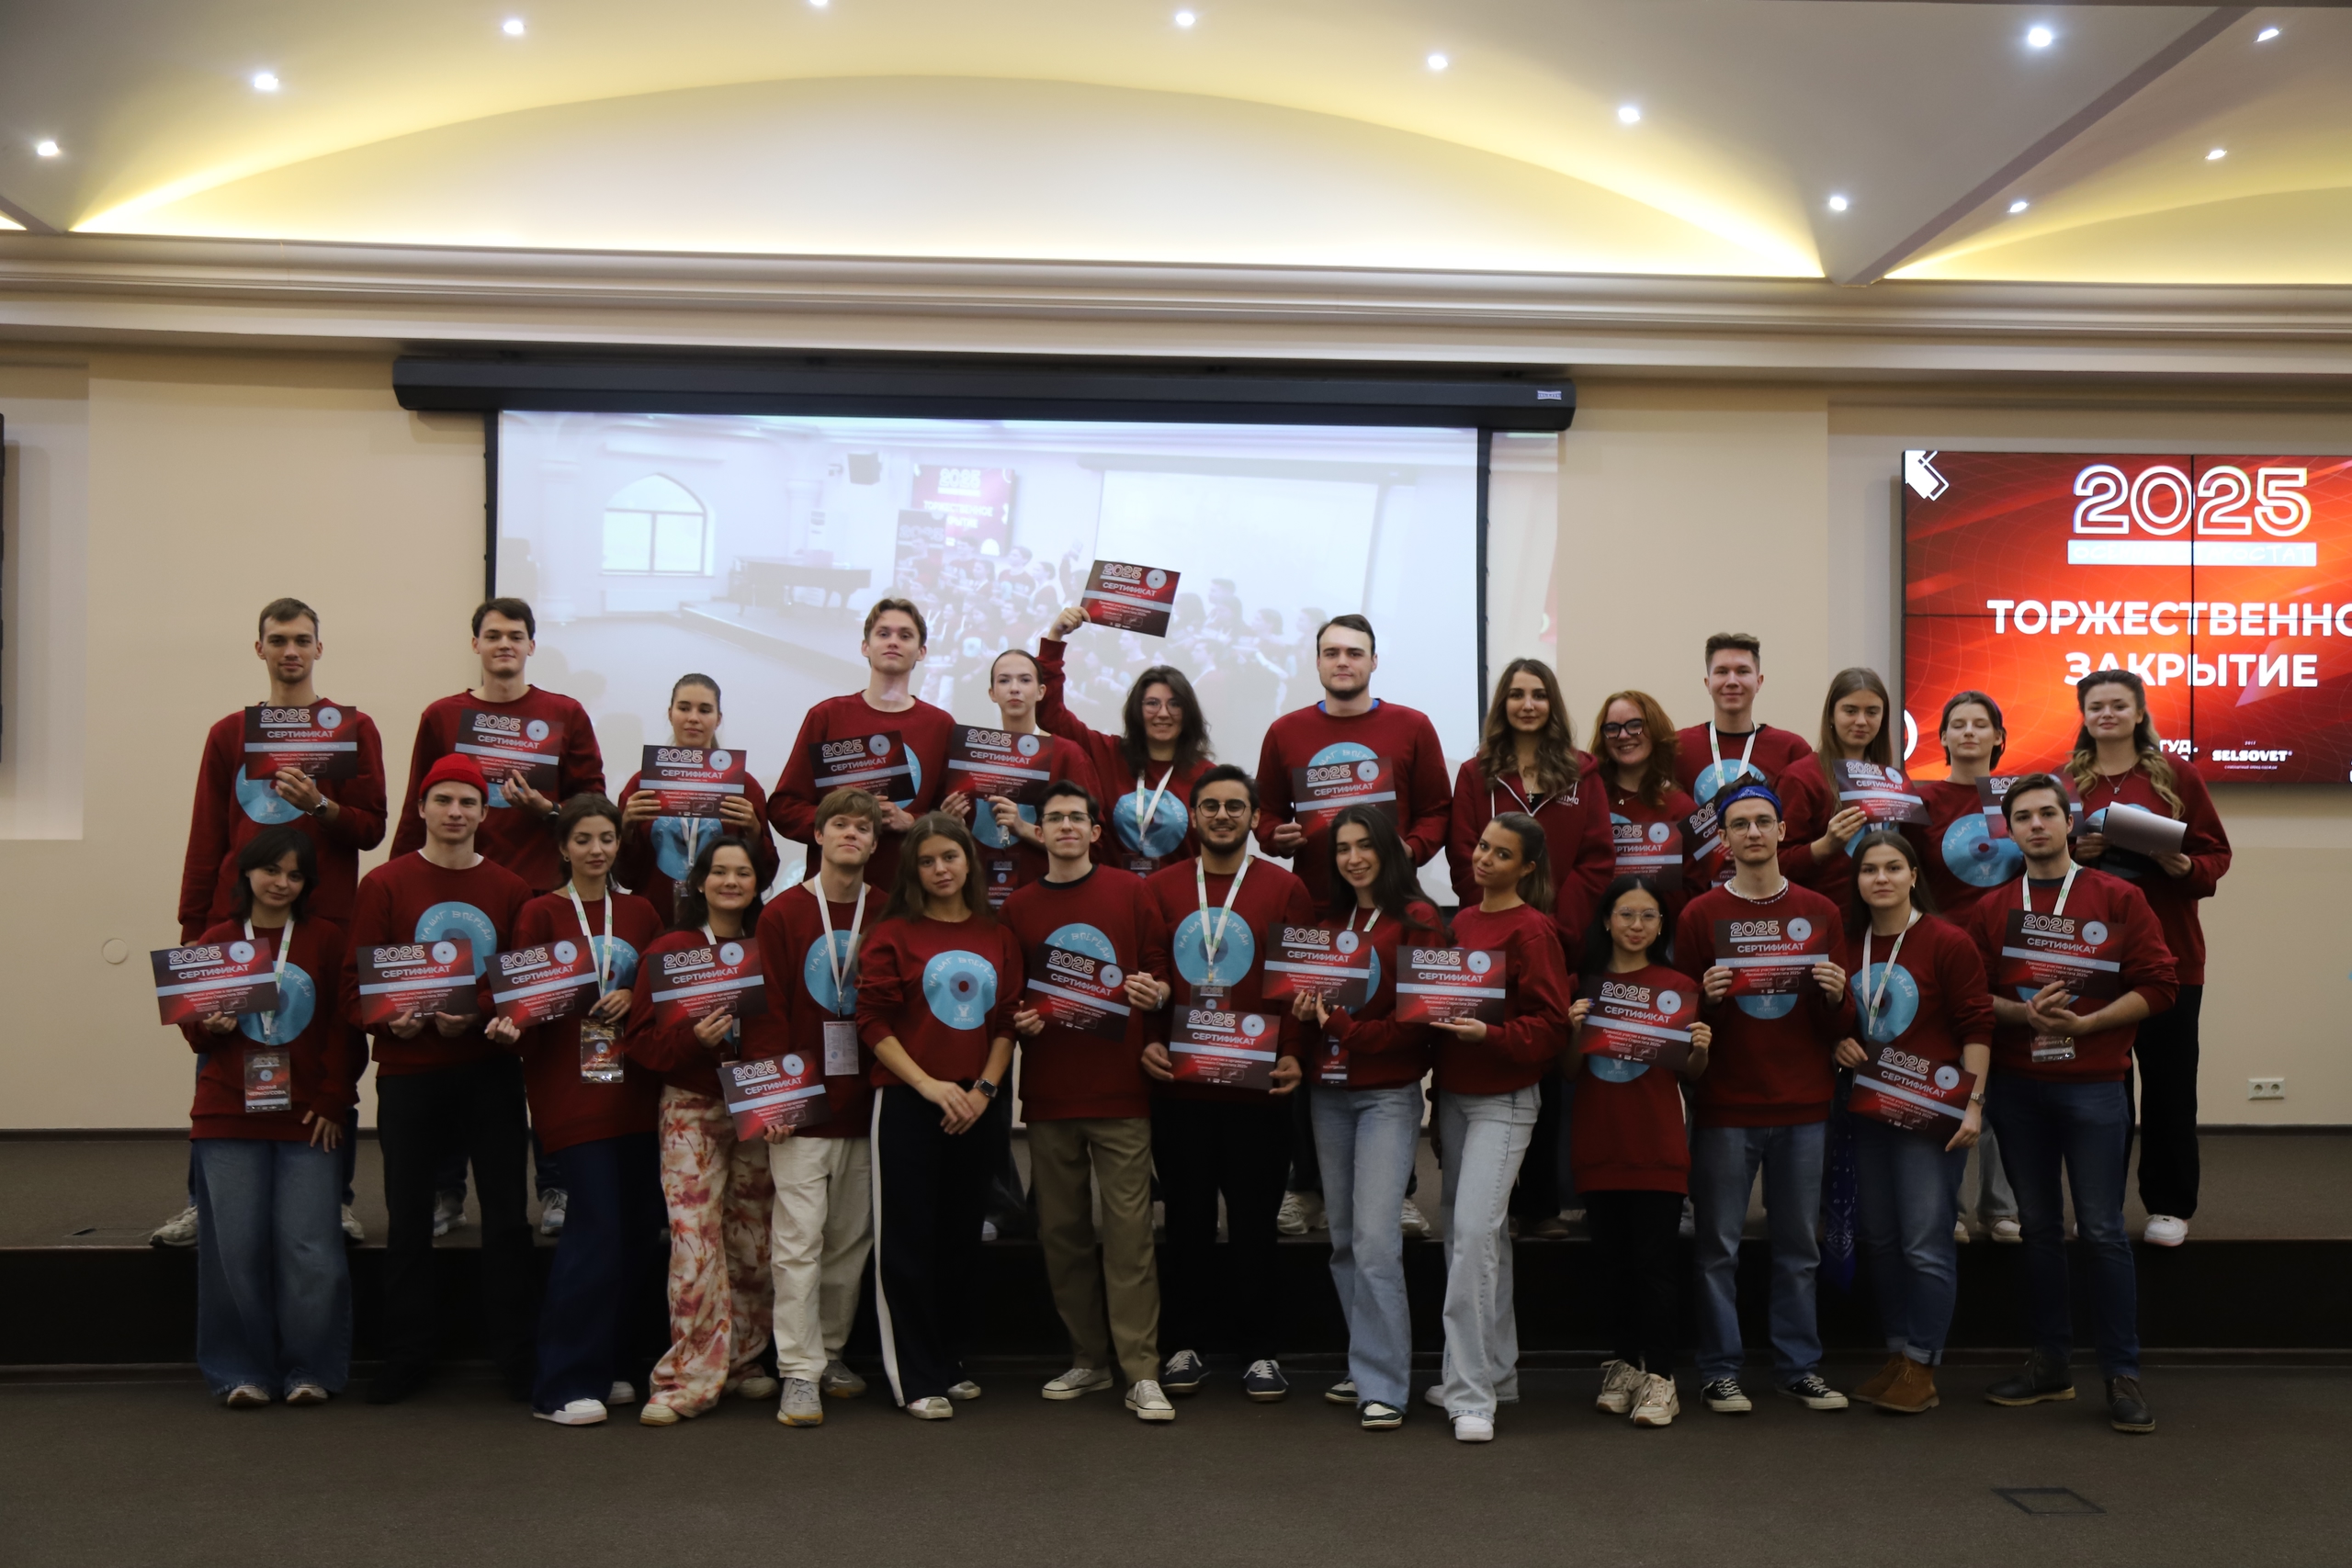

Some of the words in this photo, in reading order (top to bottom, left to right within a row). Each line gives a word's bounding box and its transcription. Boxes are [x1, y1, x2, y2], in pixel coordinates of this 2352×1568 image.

[939, 468, 981, 489] 2025
[2073, 464, 2312, 536] 2025
[1102, 562, 1143, 580] 2025
[1102, 581, 1157, 596] СЕРТИФИКАТ
[261, 708, 310, 722] 2025
[474, 713, 521, 731] 2025
[477, 734, 539, 749] СЕРТИФИКАТ
[966, 728, 1012, 747] 2025
[2158, 739, 2199, 753] ТУД.
[656, 748, 704, 763] 2025
[820, 739, 864, 758] 2025
[969, 750, 1030, 764] СЕРТИФИКАТ
[2212, 750, 2287, 761] SELSOVET
[830, 756, 887, 772] СЕРТИФИКАТ
[1306, 764, 1351, 782] 2025
[1846, 761, 1883, 776] 2025
[661, 769, 723, 779] СЕРТИФИКАТ
[1314, 783, 1374, 795] СЕРТИФИКАТ
[1690, 802, 1716, 829] 202
[1611, 824, 1643, 839] 025
[1614, 844, 1662, 852] РТИФИКАТ
[421, 927, 431, 941] НА
[428, 910, 447, 927] ШАГ
[451, 910, 492, 942] ВПЕРЕДИ
[1213, 916, 1250, 946] ВЕРЕДИ
[1729, 920, 1780, 936] 2025
[2022, 913, 2075, 934] 2025
[1283, 926, 1330, 945] 2025
[373, 944, 425, 963] 2025
[1071, 932, 1111, 959] ВПЕРЕДИ
[1736, 942, 1804, 953] СЕРТИФИКАТ
[2026, 937, 2097, 953] СЕРТИФИКАТ
[167, 945, 222, 964] 2025
[499, 946, 548, 970] 2025
[662, 947, 713, 969] 2025
[1048, 948, 1096, 975] 2025
[1286, 950, 1350, 963] СЕРТИФИКАТ
[1412, 948, 1460, 965] 2025
[177, 964, 250, 979] СЕРТИФИКАТ
[381, 964, 451, 977] СЕРТИФИКАТ
[511, 964, 574, 985] СЕРТИФИКАТ
[672, 966, 739, 984] СЕРТИФИКАТ
[928, 973, 938, 987] НА
[935, 956, 953, 972] ШАГ
[1418, 972, 1483, 982] СЕРТИФИКАТ
[282, 970, 311, 998] ПЕРЕДИ
[1050, 972, 1112, 997] СЕРТИФИКАТ
[1600, 980, 1651, 1003] 2025
[1188, 1009, 1236, 1027] 2025
[1603, 1005, 1670, 1023] СЕРТИФИКАТ
[1191, 1032, 1255, 1045] СЕРТИФИКАТ
[1879, 1045, 1931, 1075] 2025
[731, 1059, 778, 1081] 2025
[743, 1077, 803, 1095] СЕРТИФИКАТ
[1880, 1069, 1946, 1099] СЕРТИФИКАТ
